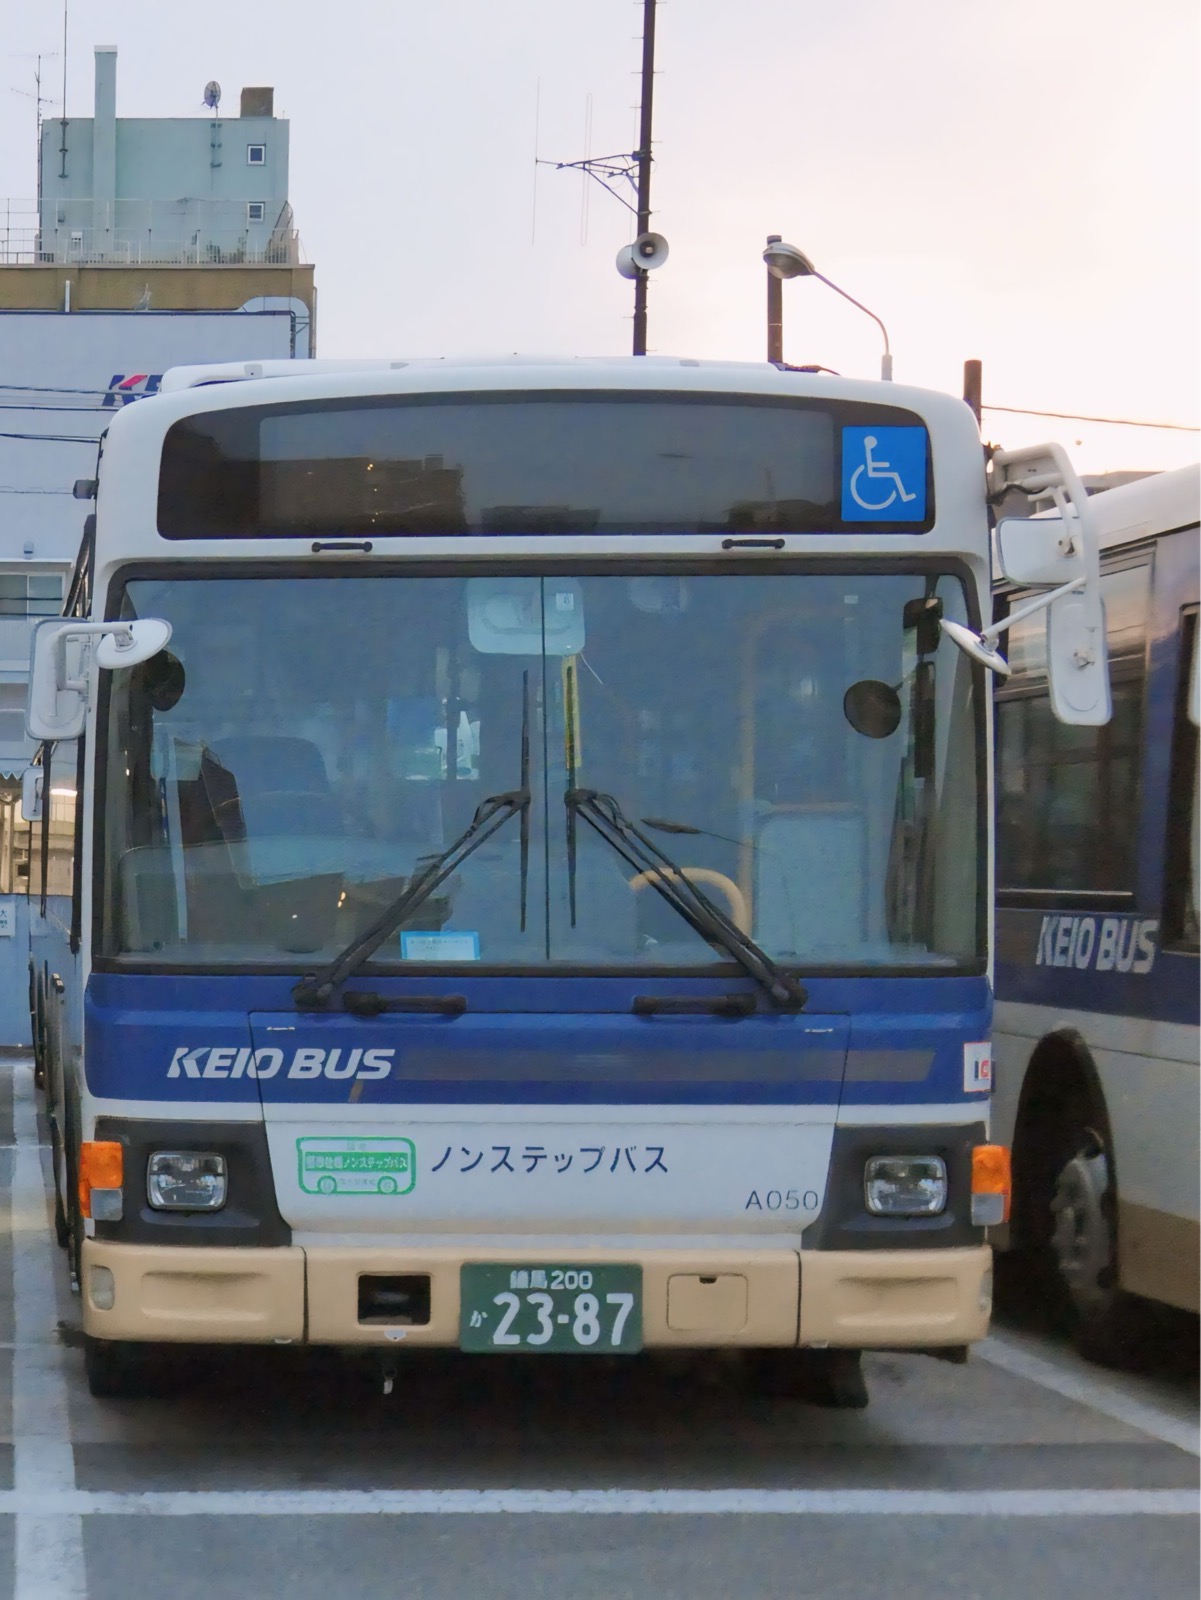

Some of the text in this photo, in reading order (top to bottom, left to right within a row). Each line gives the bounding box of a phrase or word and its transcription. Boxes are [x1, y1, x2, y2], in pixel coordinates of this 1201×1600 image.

[1035, 915, 1159, 974] KEIO BUS
[167, 1047, 396, 1080] KEIO BUS
[431, 1145, 668, 1173] ノンステップバス
[745, 1189, 819, 1211] A050
[550, 1270, 593, 1290] 200
[493, 1292, 634, 1346] 23-87
